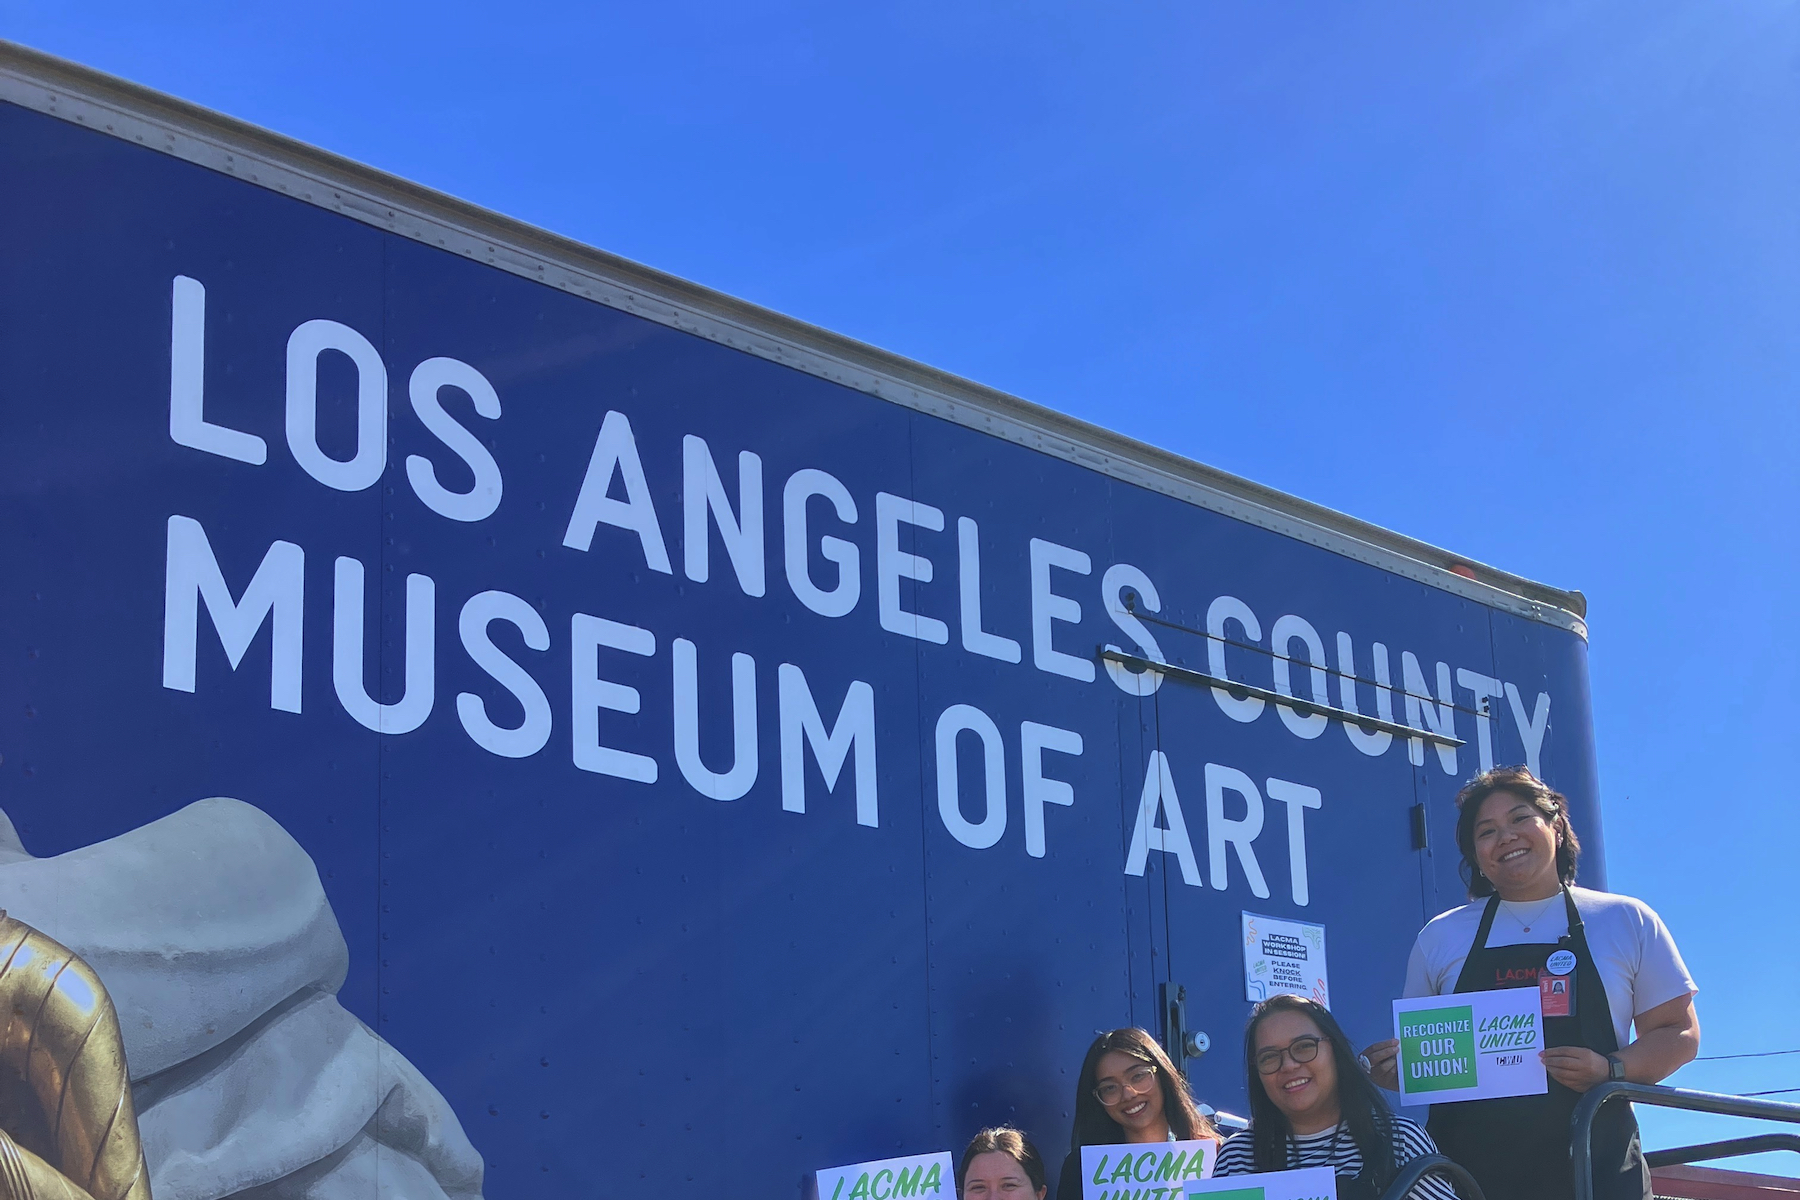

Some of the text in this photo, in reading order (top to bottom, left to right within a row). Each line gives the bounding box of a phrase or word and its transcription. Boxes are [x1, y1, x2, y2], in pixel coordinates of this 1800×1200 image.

[170, 275, 1552, 778] LOS ANGELES COUNTY
[163, 514, 1322, 906] MUSEUM OF ART
[1263, 940, 1306, 952] WORKSHOP
[1270, 934, 1298, 944] LACMA
[1271, 960, 1301, 969] PLEASE
[1273, 968, 1301, 976] KNOCK
[1495, 966, 1544, 981] LACM
[1403, 1019, 1471, 1038] RECOGNIZE
[1478, 1013, 1535, 1033] LACMA
[1420, 1038, 1455, 1057] OUR
[1479, 1030, 1536, 1050] UNITED
[1411, 1058, 1468, 1079] UNION!
[1092, 1149, 1204, 1185] LACMA
